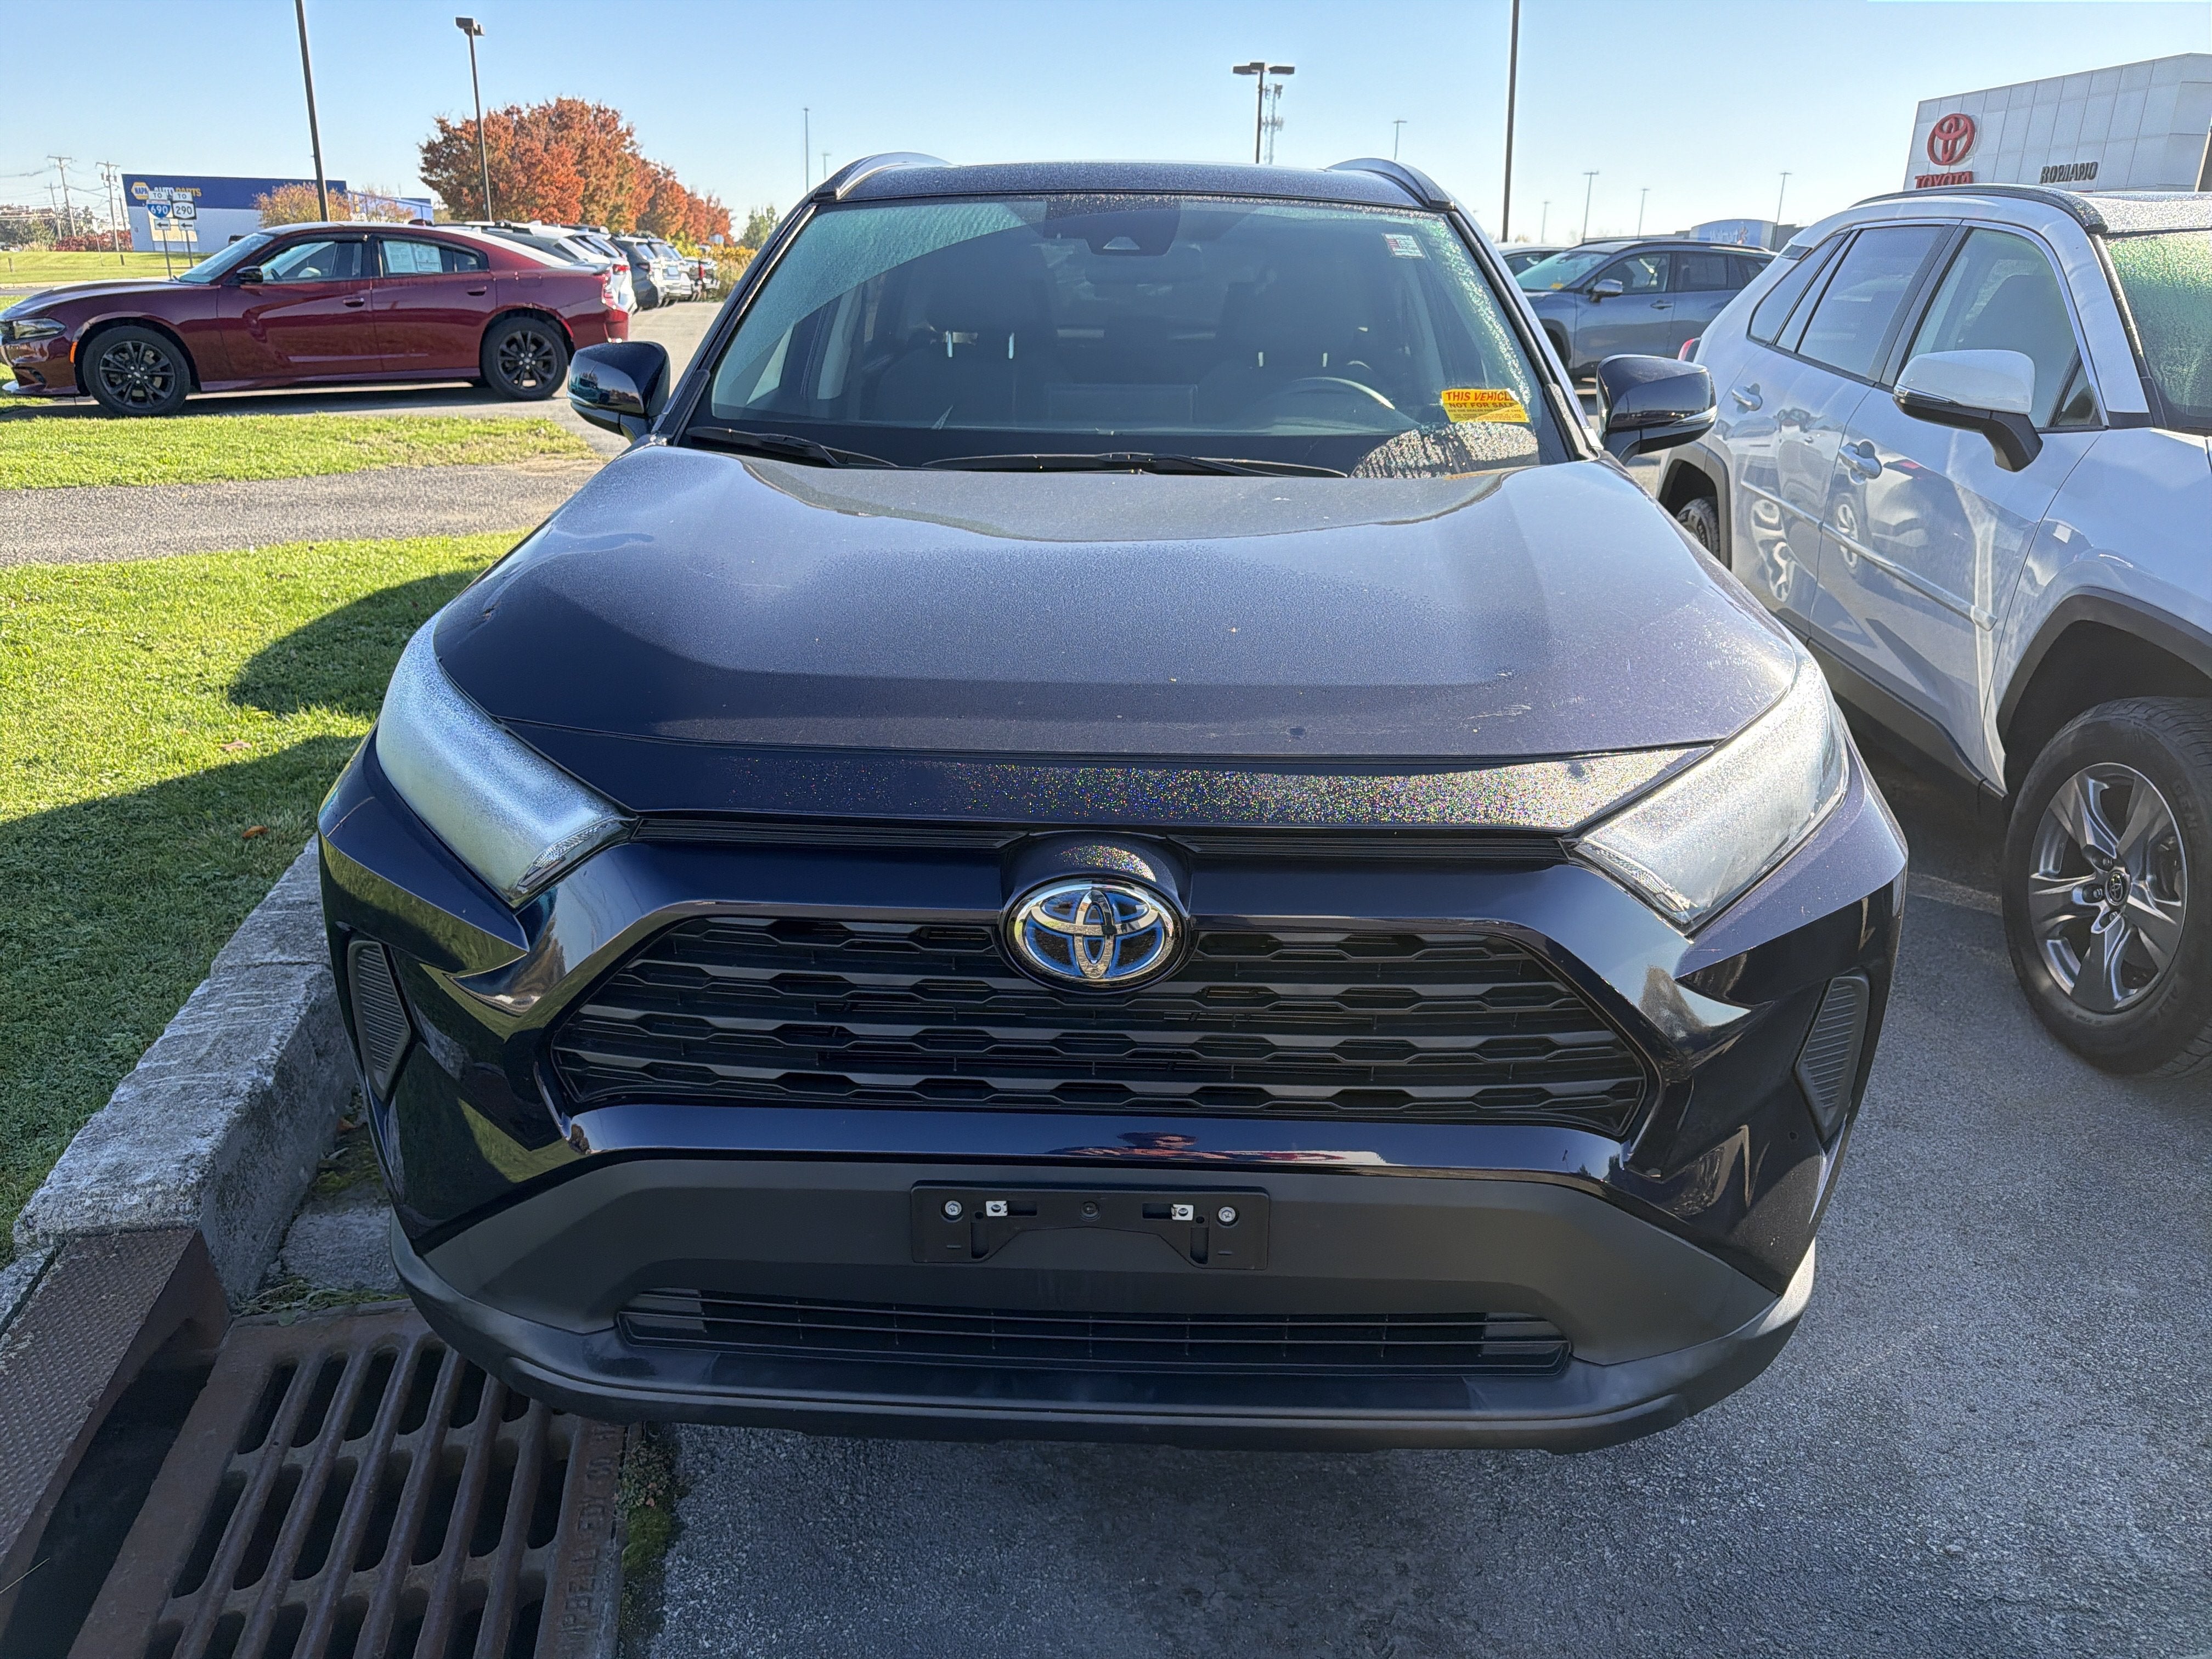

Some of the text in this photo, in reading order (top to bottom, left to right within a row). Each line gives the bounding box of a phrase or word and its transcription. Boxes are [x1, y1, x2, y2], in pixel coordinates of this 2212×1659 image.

[2039, 162, 2098, 184] ROMANO
[1914, 171, 1973, 189] TOYOTA
[150, 206, 168, 215] 690
[176, 206, 193, 215] 290
[1446, 391, 1515, 401] THIS VEHICL
